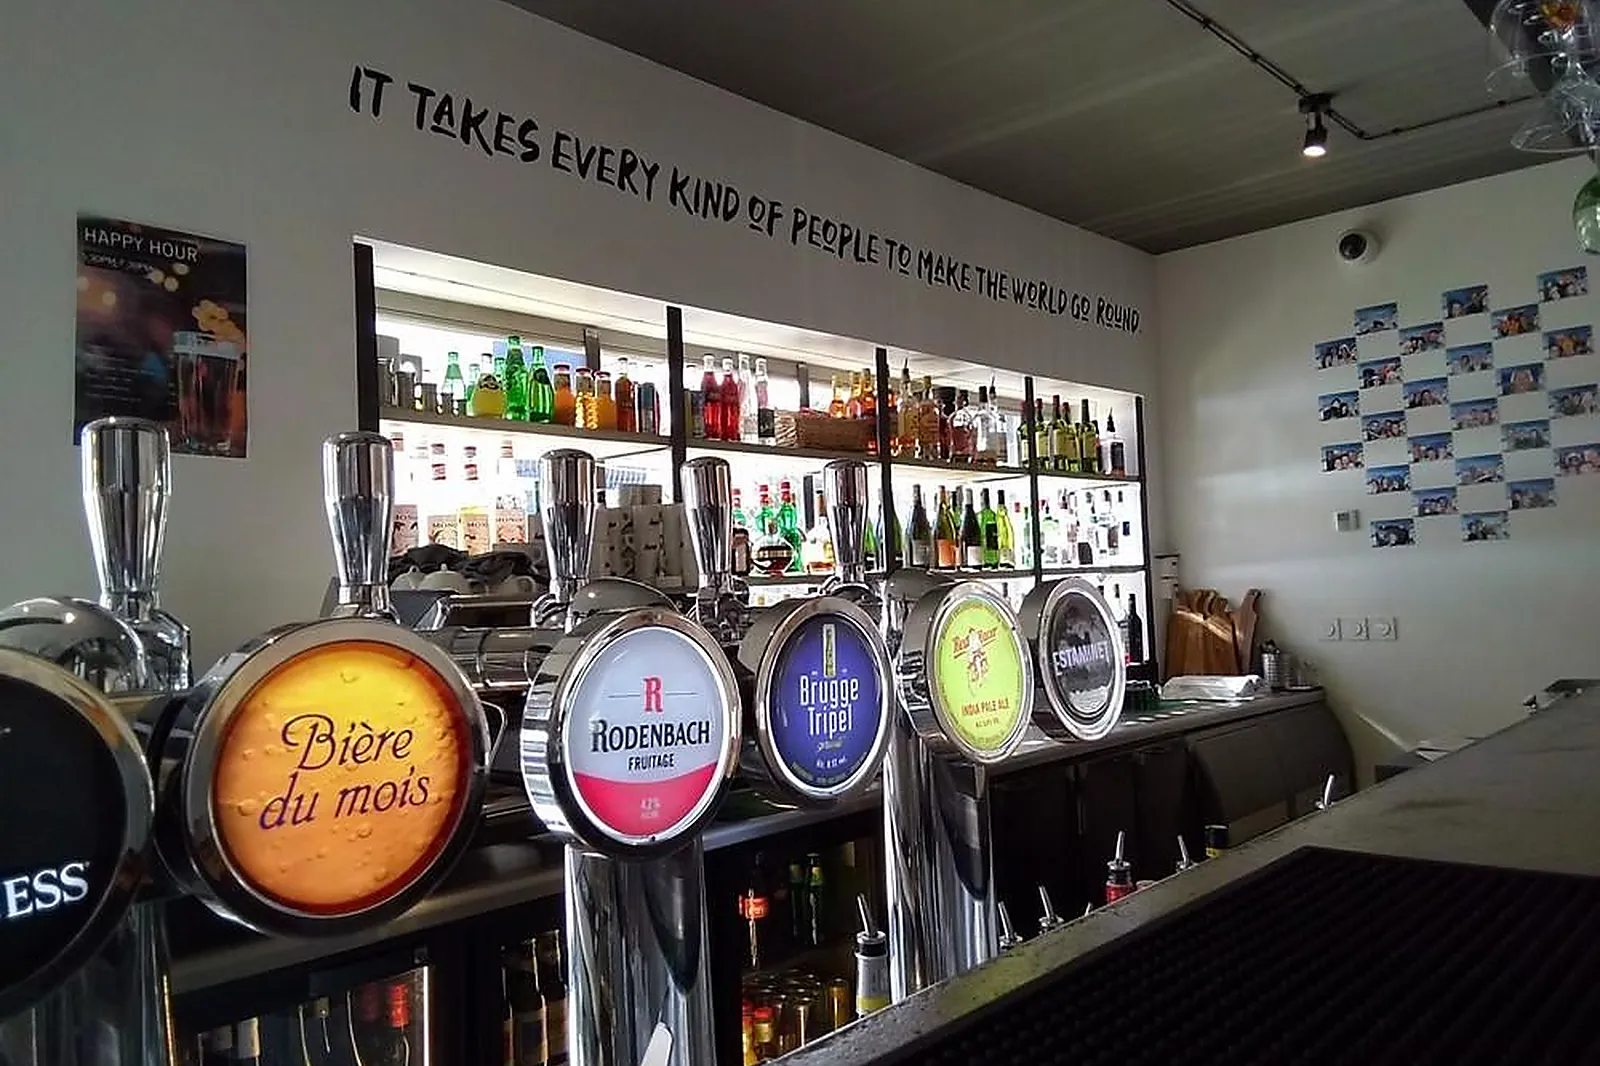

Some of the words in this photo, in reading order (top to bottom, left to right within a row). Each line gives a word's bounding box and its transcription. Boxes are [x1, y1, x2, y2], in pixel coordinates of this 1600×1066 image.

[350, 66, 393, 117] IT
[408, 83, 540, 163] TAKES
[551, 131, 660, 202] EVERY
[669, 167, 740, 222] KIND
[748, 195, 783, 237] OF
[791, 207, 880, 264] PEOPLE
[885, 238, 912, 276] TO
[917, 250, 971, 292] MAKE
[975, 265, 1008, 301] THE
[1012, 278, 1067, 316] WORLD
[1071, 293, 1091, 322] GO
[84, 227, 144, 252] HAPPY
[149, 239, 198, 262] HOUR
[642, 676, 664, 713] R
[799, 674, 859, 709] Brugge
[590, 718, 711, 753] RODENBACH
[807, 702, 852, 740] Tripel
[281, 713, 413, 771] Bière
[627, 752, 675, 771] FRUITAGE
[259, 770, 320, 831] du
[334, 765, 431, 819] mois
